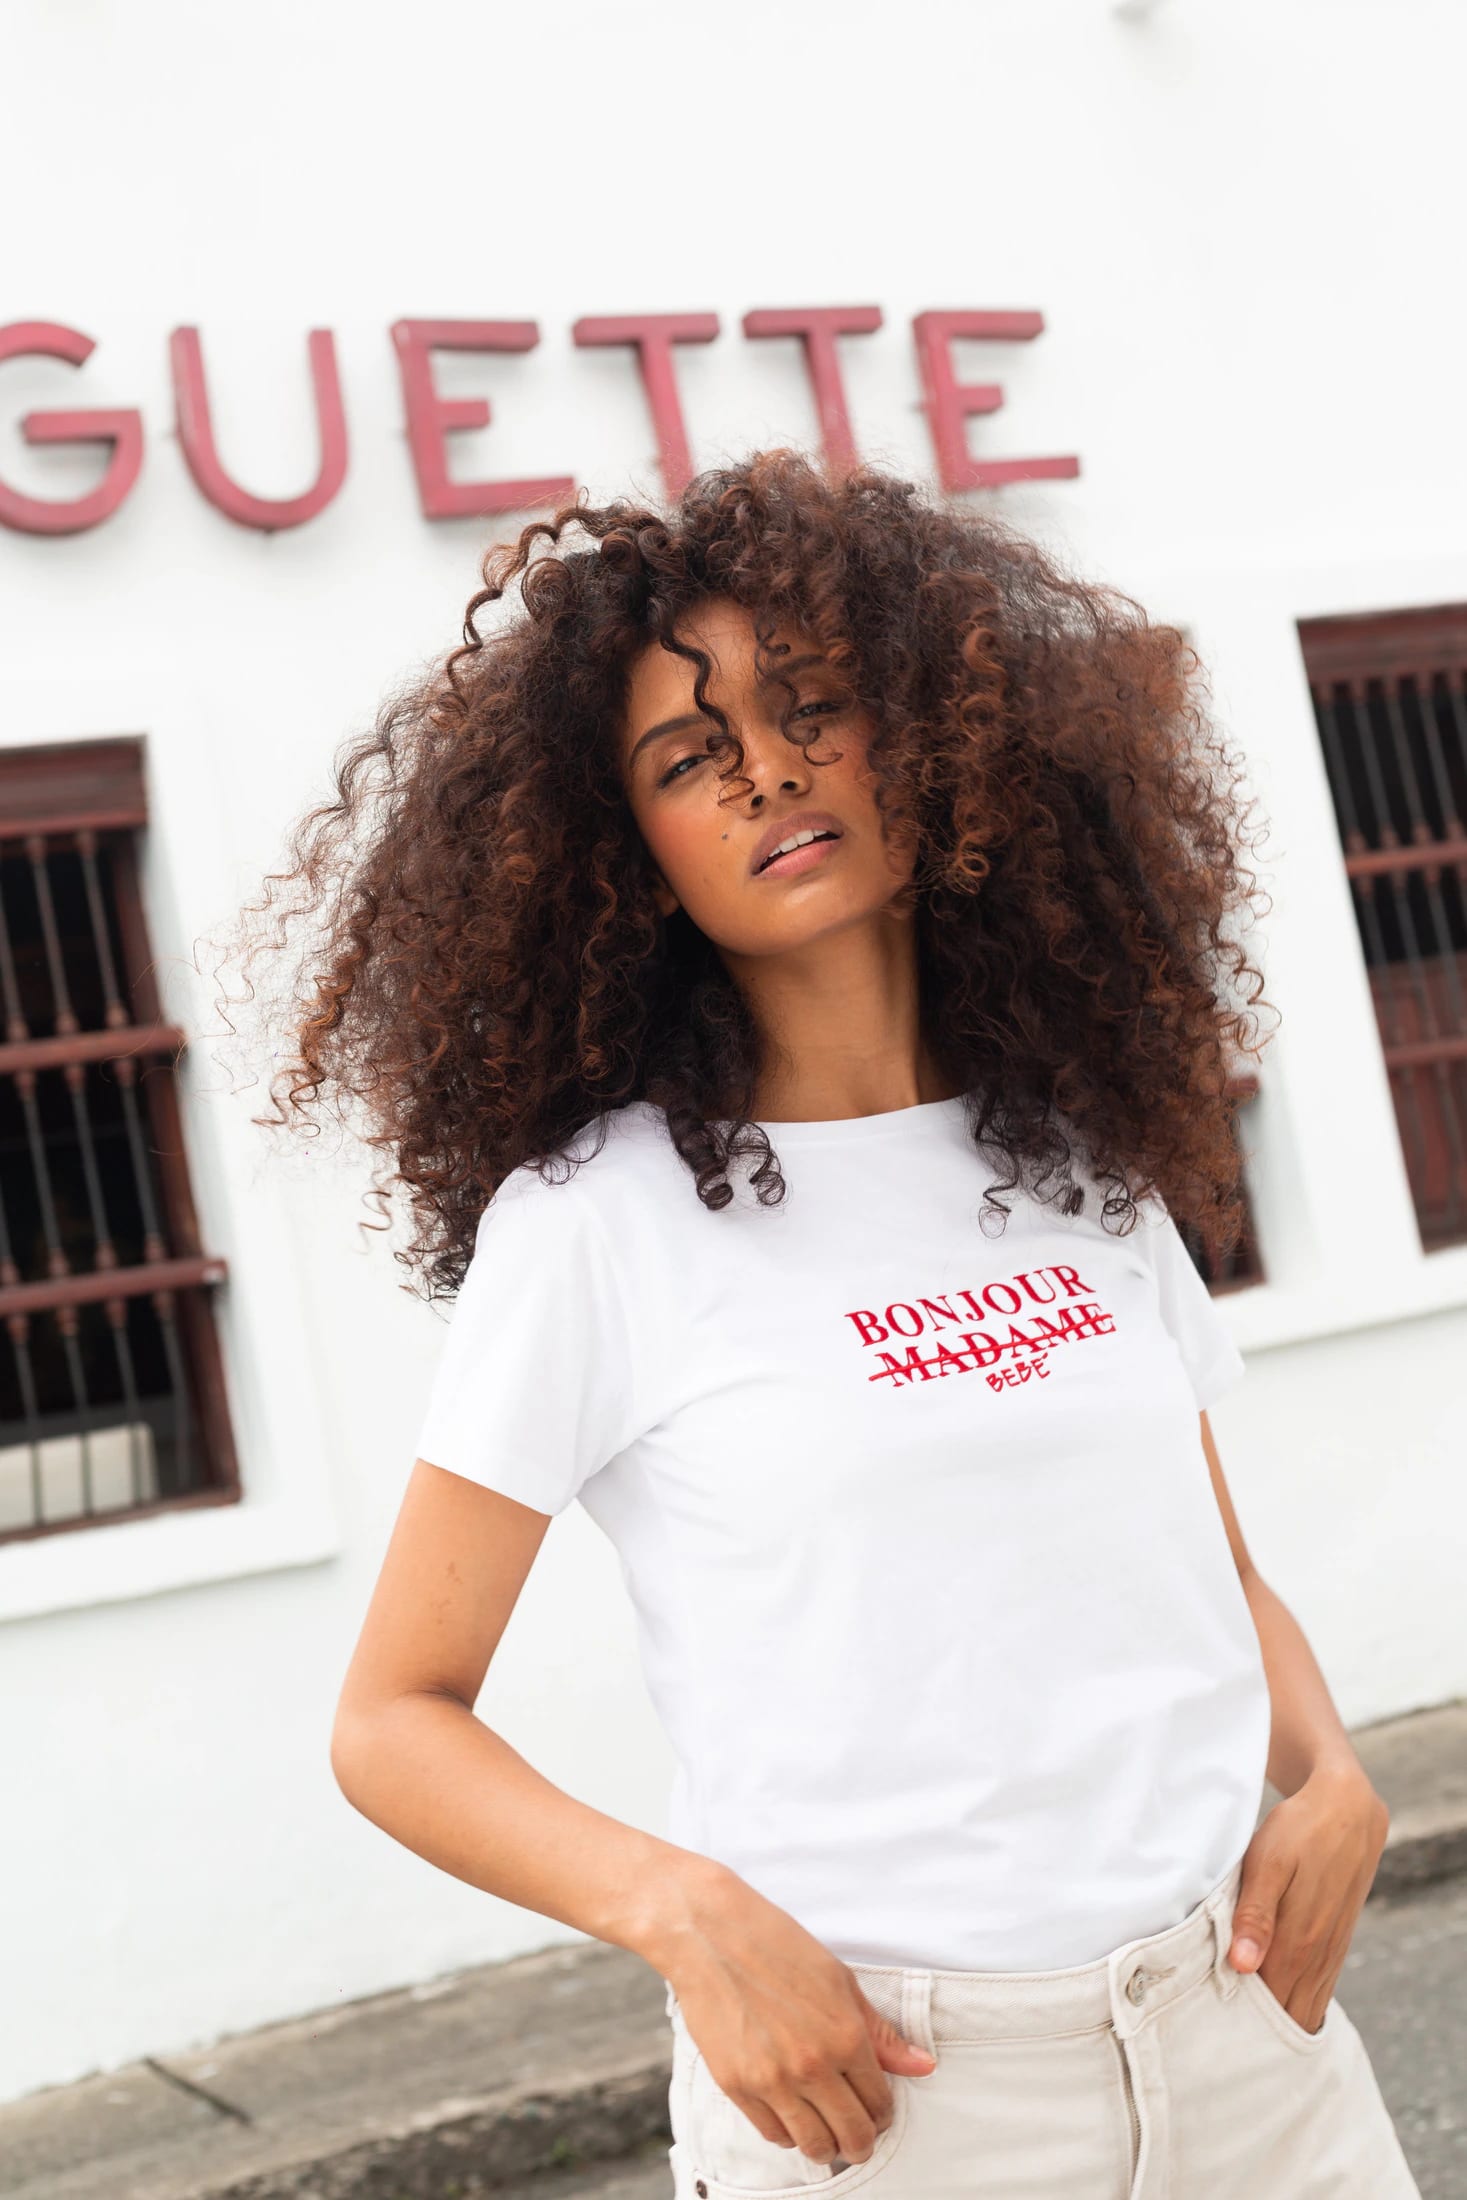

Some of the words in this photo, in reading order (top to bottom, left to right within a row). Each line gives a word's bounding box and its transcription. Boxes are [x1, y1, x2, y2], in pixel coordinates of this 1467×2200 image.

[0, 305, 1081, 536] GUETTE
[844, 1265, 1096, 1347] BONJOUR
[872, 1303, 1117, 1387] MADAME
